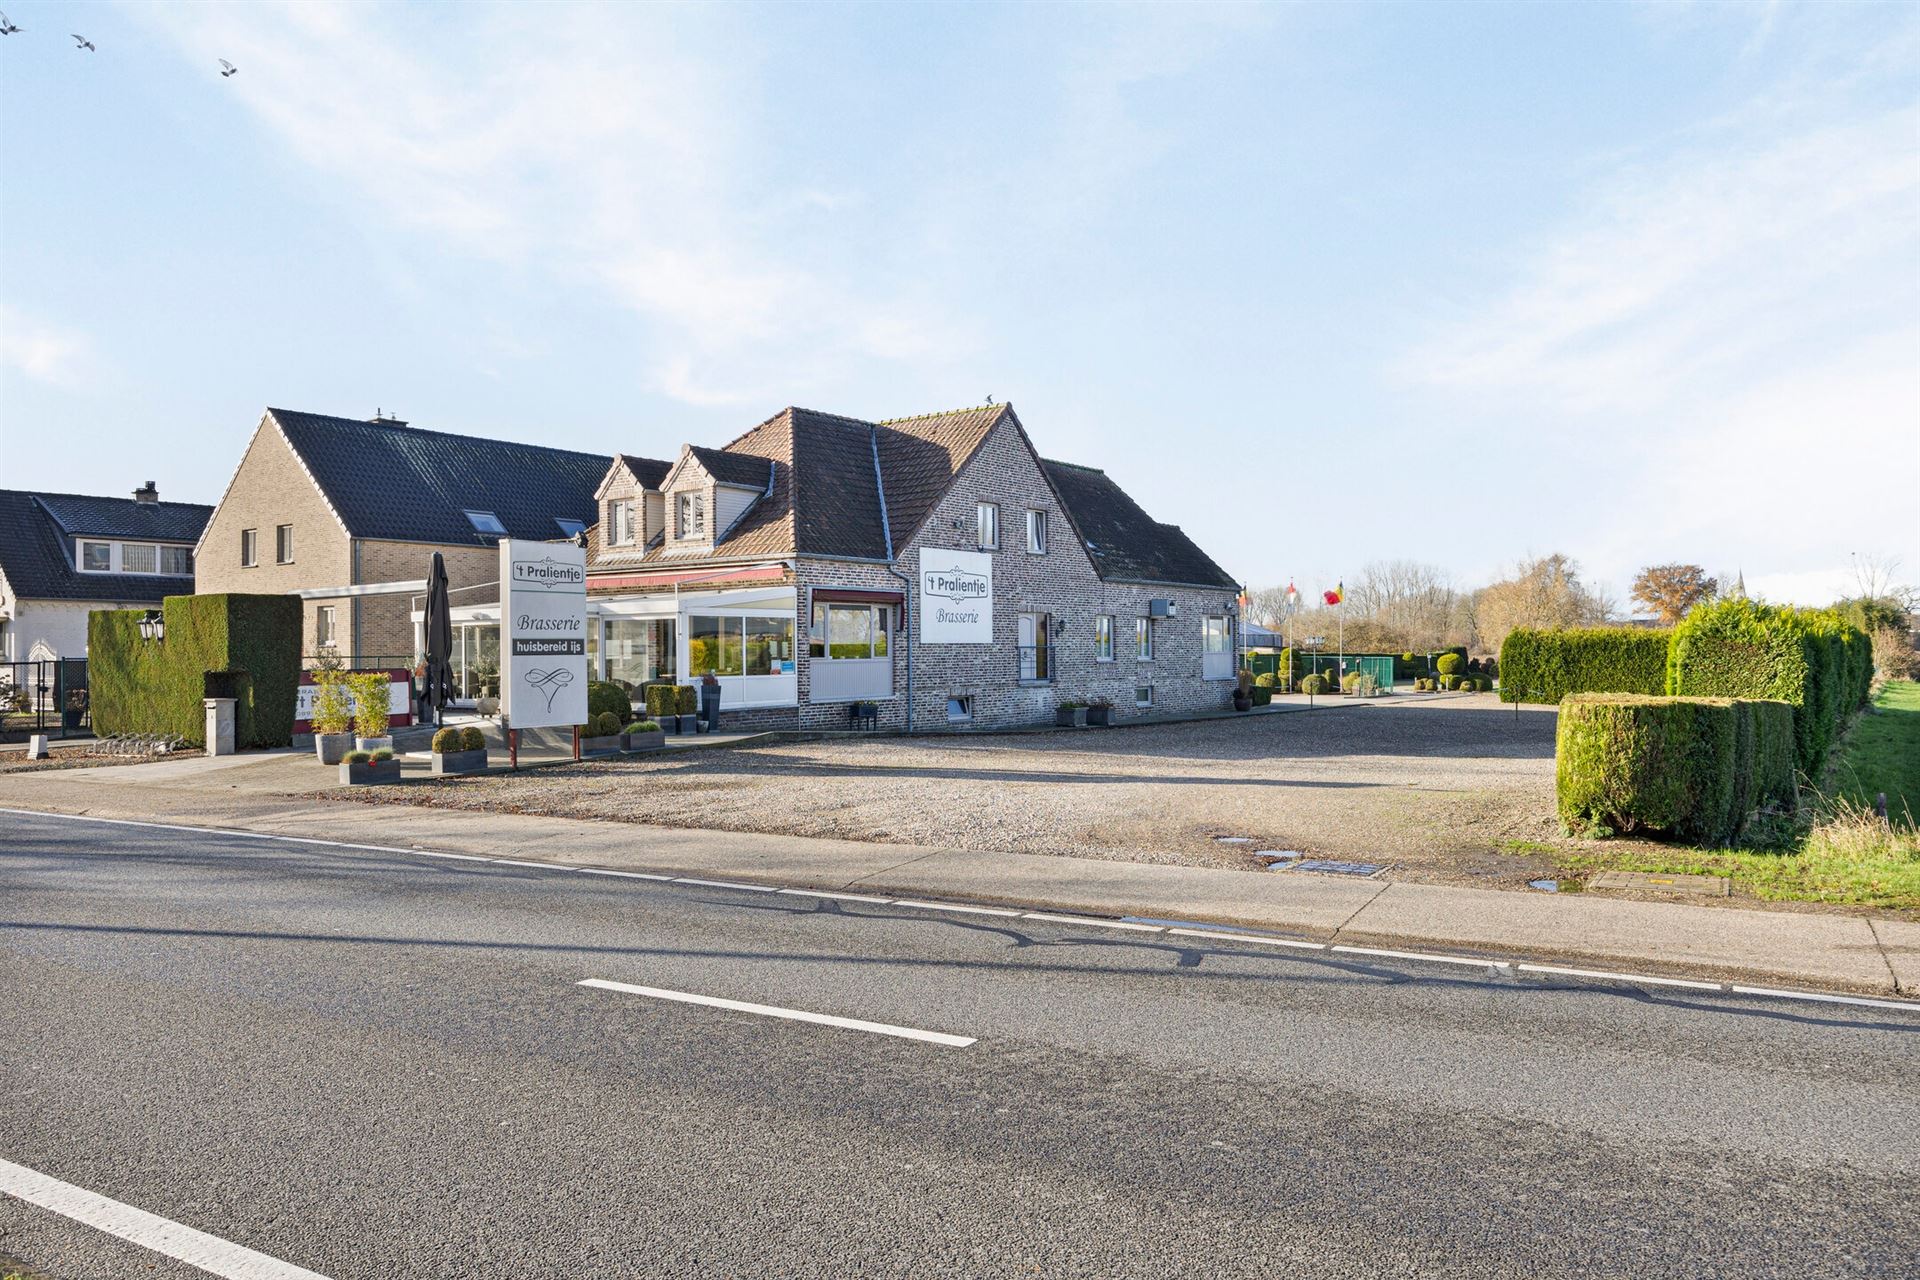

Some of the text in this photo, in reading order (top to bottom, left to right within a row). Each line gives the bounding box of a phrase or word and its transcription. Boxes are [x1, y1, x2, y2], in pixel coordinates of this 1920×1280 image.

[527, 565, 580, 582] Pralientje
[938, 577, 985, 596] Pralientje
[517, 614, 580, 631] Brasserie
[936, 608, 979, 624] Brasserie
[517, 640, 581, 653] huisbereid ijs
